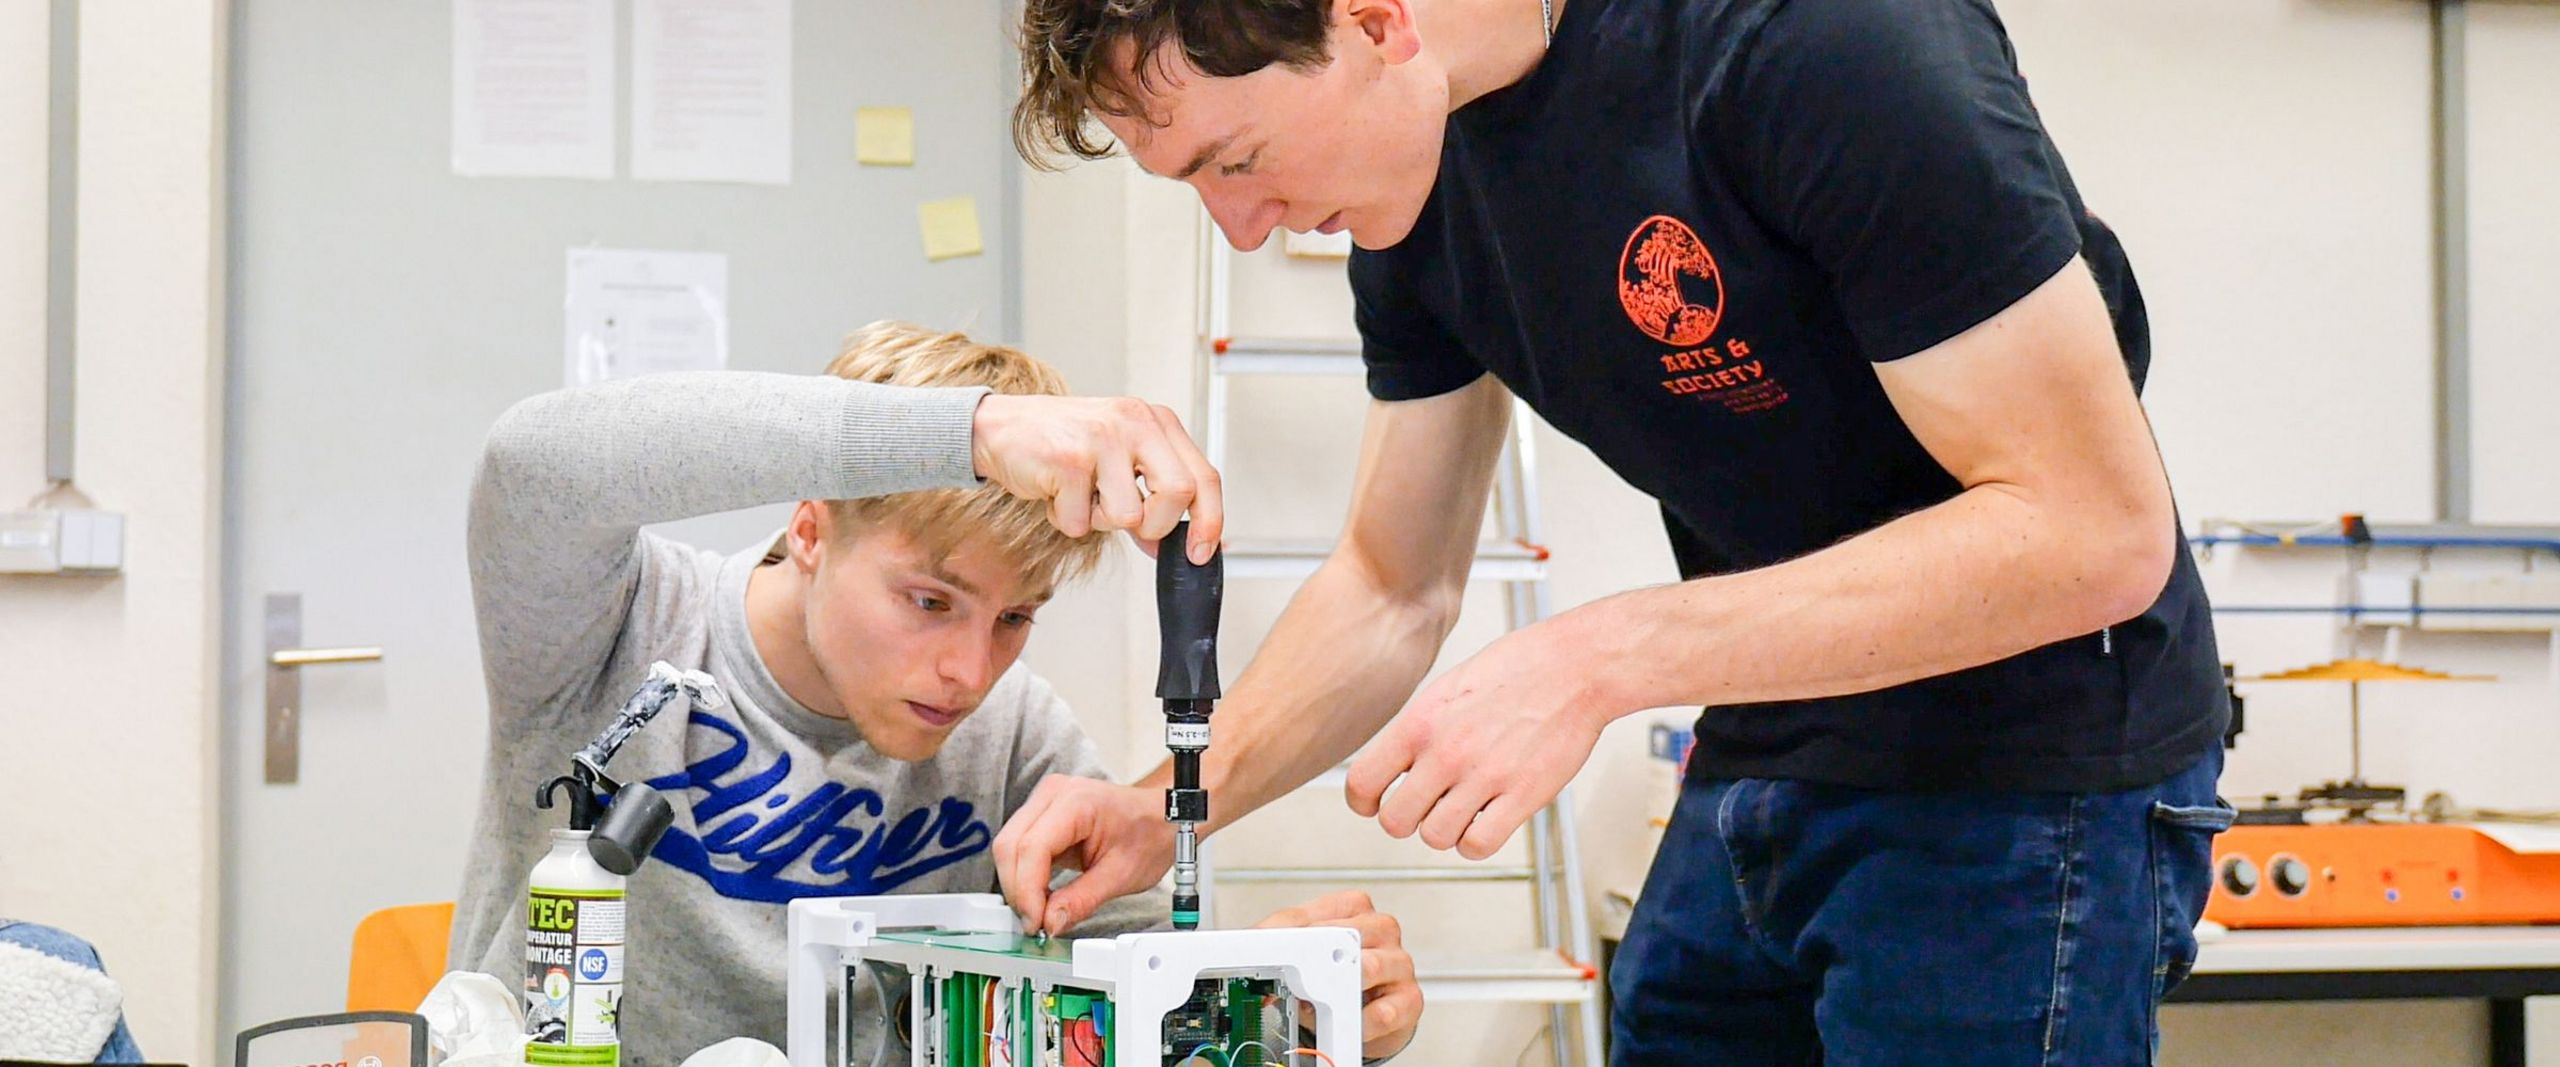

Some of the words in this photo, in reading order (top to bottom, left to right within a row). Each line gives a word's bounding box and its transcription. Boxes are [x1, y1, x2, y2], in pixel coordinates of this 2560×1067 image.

[1660, 346, 1723, 373] ARTS
[1726, 338, 1751, 358] &
[1661, 359, 1764, 395] SOCIETY
[528, 897, 574, 930] TEC
